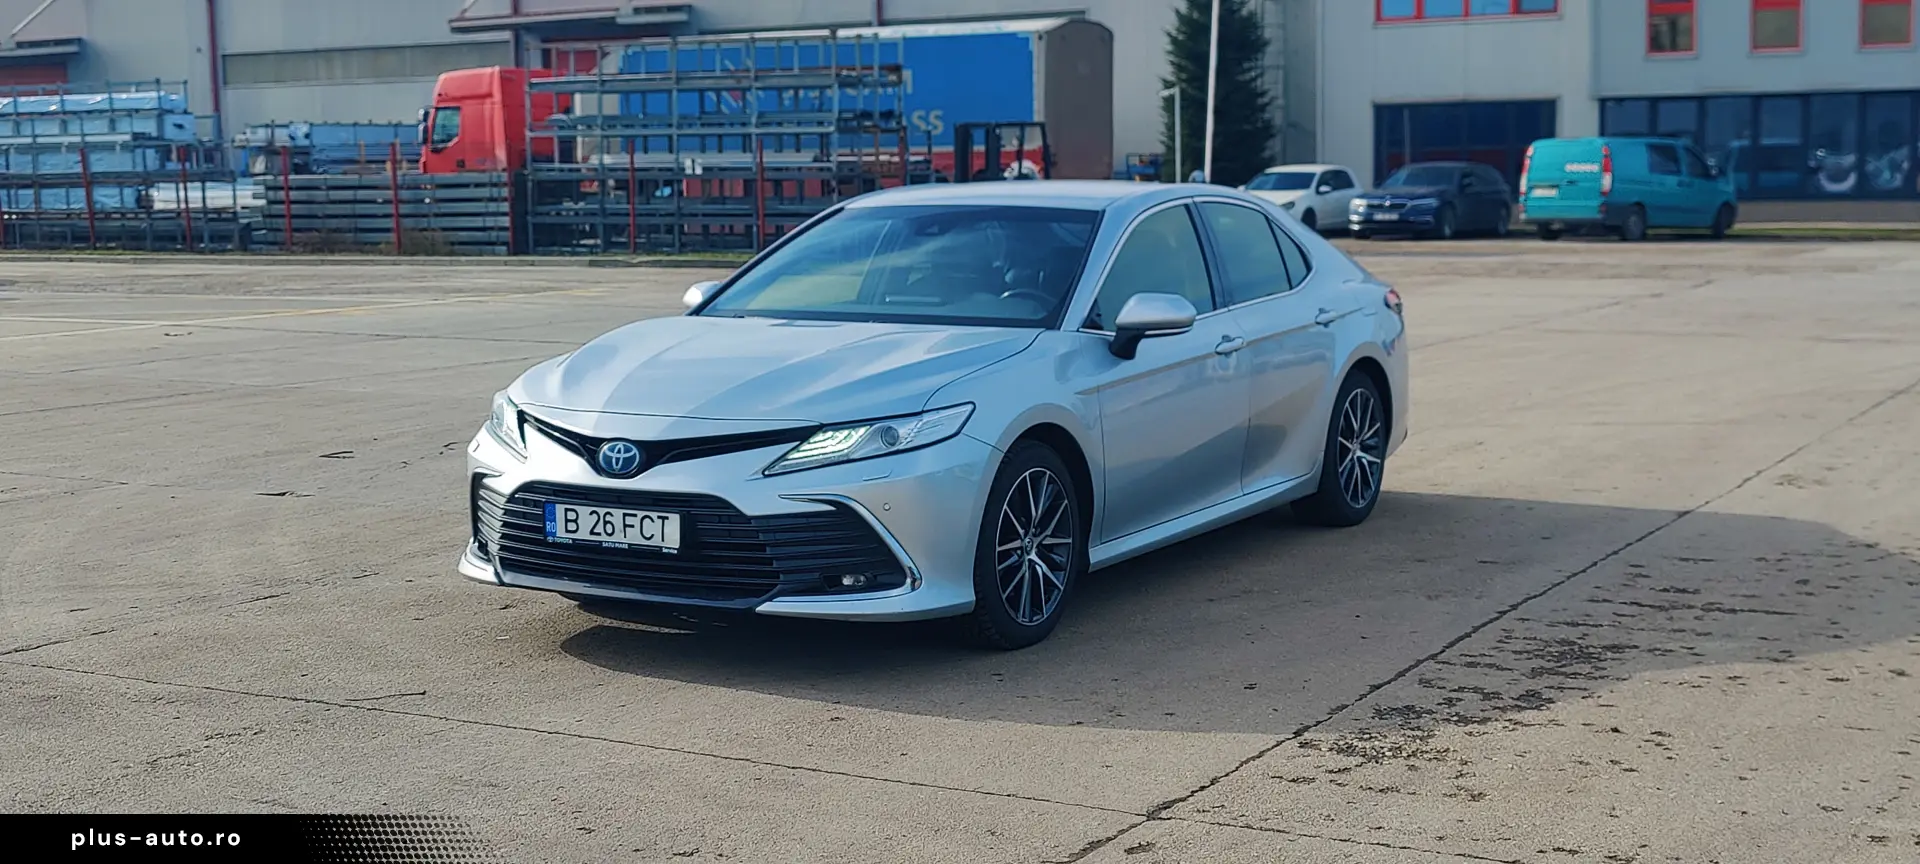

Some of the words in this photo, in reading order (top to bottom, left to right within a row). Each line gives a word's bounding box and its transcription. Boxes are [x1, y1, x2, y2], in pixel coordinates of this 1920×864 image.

[546, 521, 556, 532] RO
[564, 507, 580, 534] B
[588, 509, 616, 537] 26
[622, 512, 670, 542] FCT
